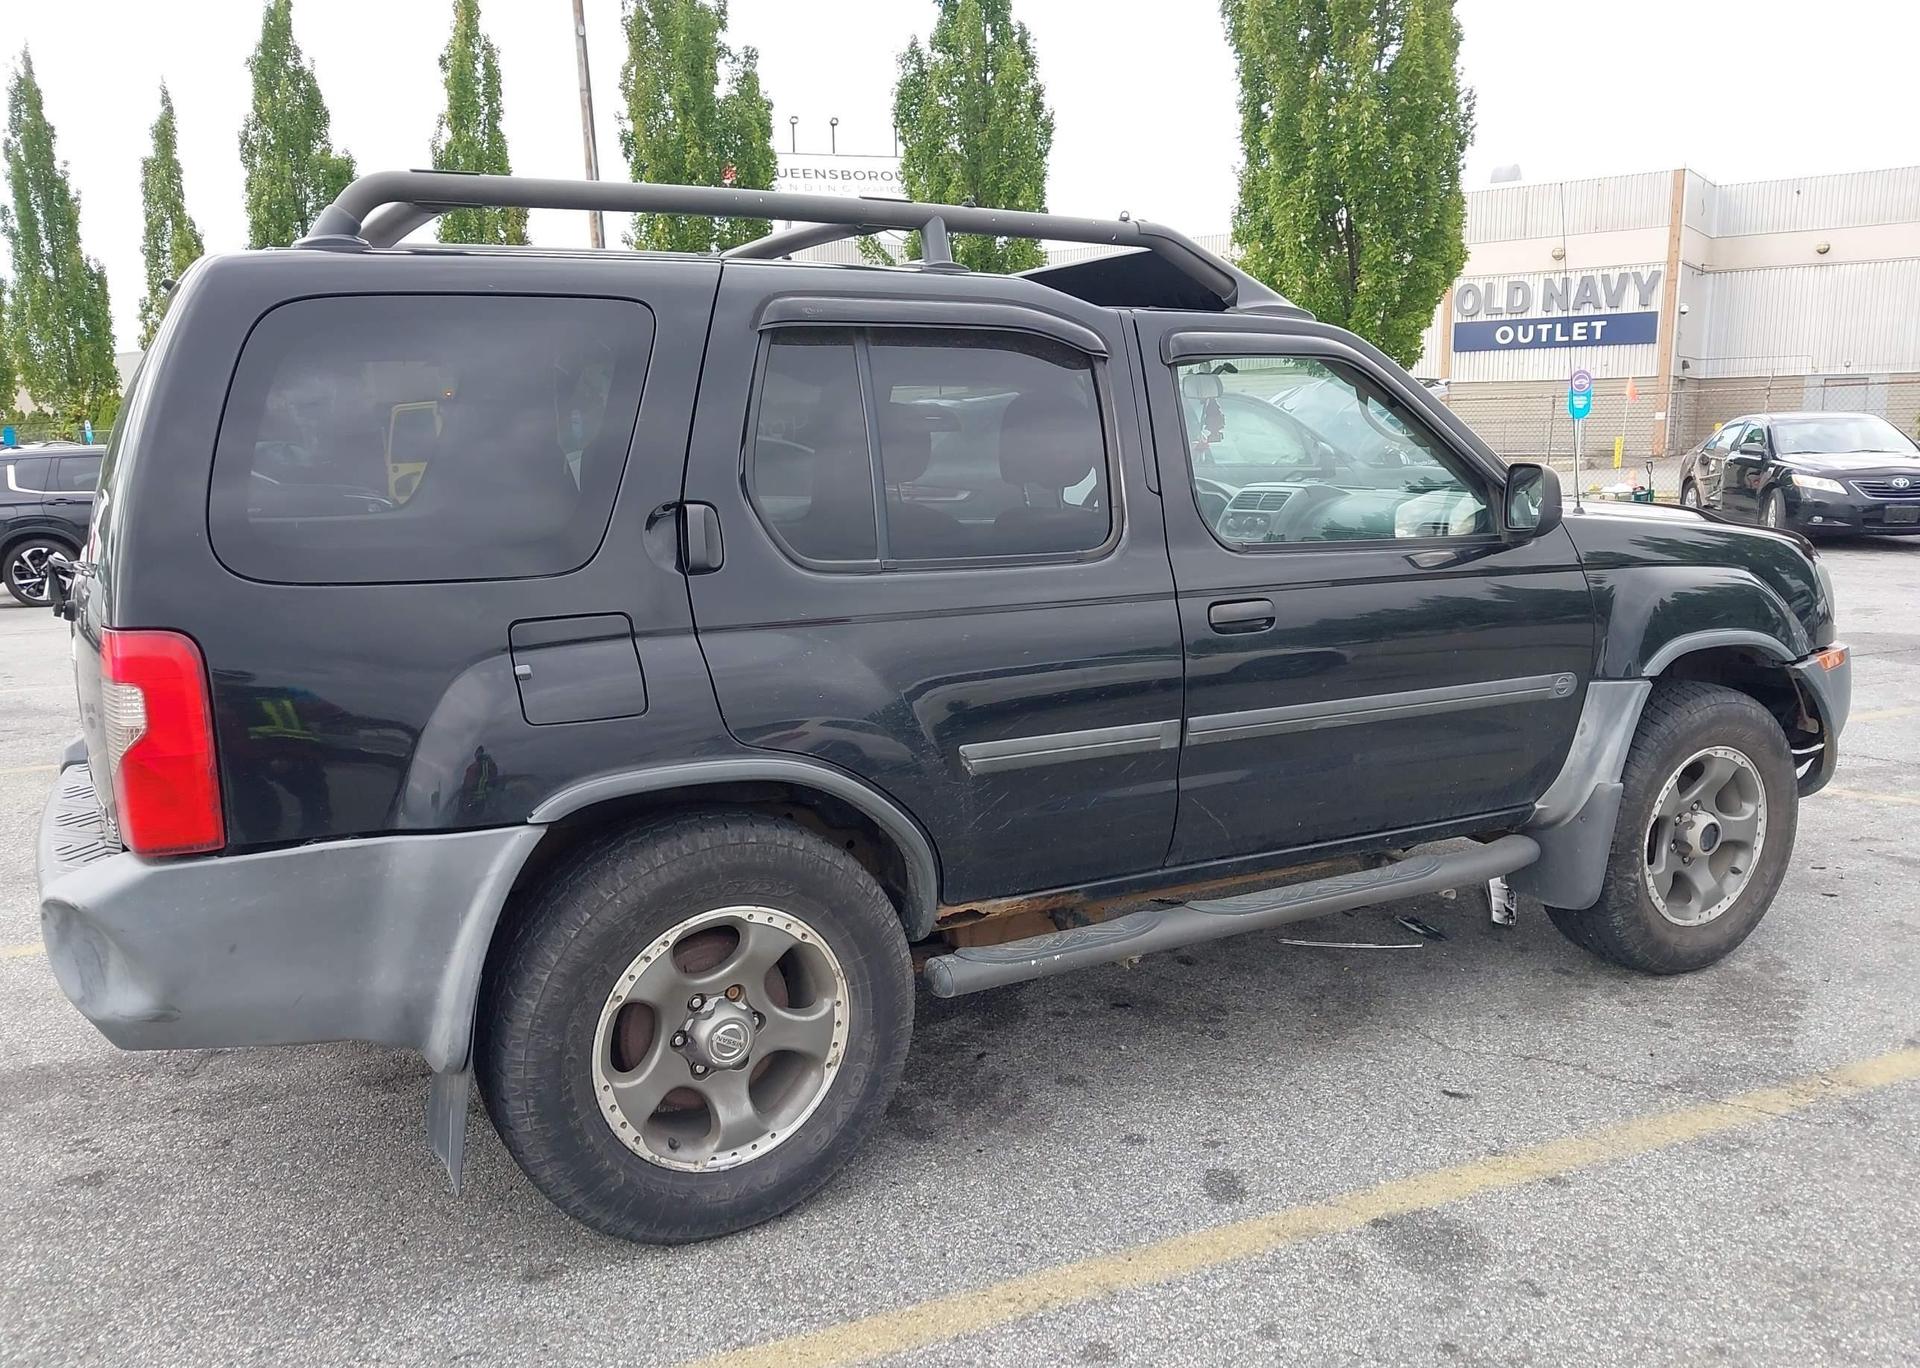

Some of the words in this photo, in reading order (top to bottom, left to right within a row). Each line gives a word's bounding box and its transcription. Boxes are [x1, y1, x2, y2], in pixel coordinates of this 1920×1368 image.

[776, 167, 904, 182] UEENSBOROU
[1455, 281, 1531, 317] OLD
[1542, 270, 1662, 312] NAVY
[1495, 320, 1607, 345] OUTLET
[715, 1035, 744, 1048] NISSAN
